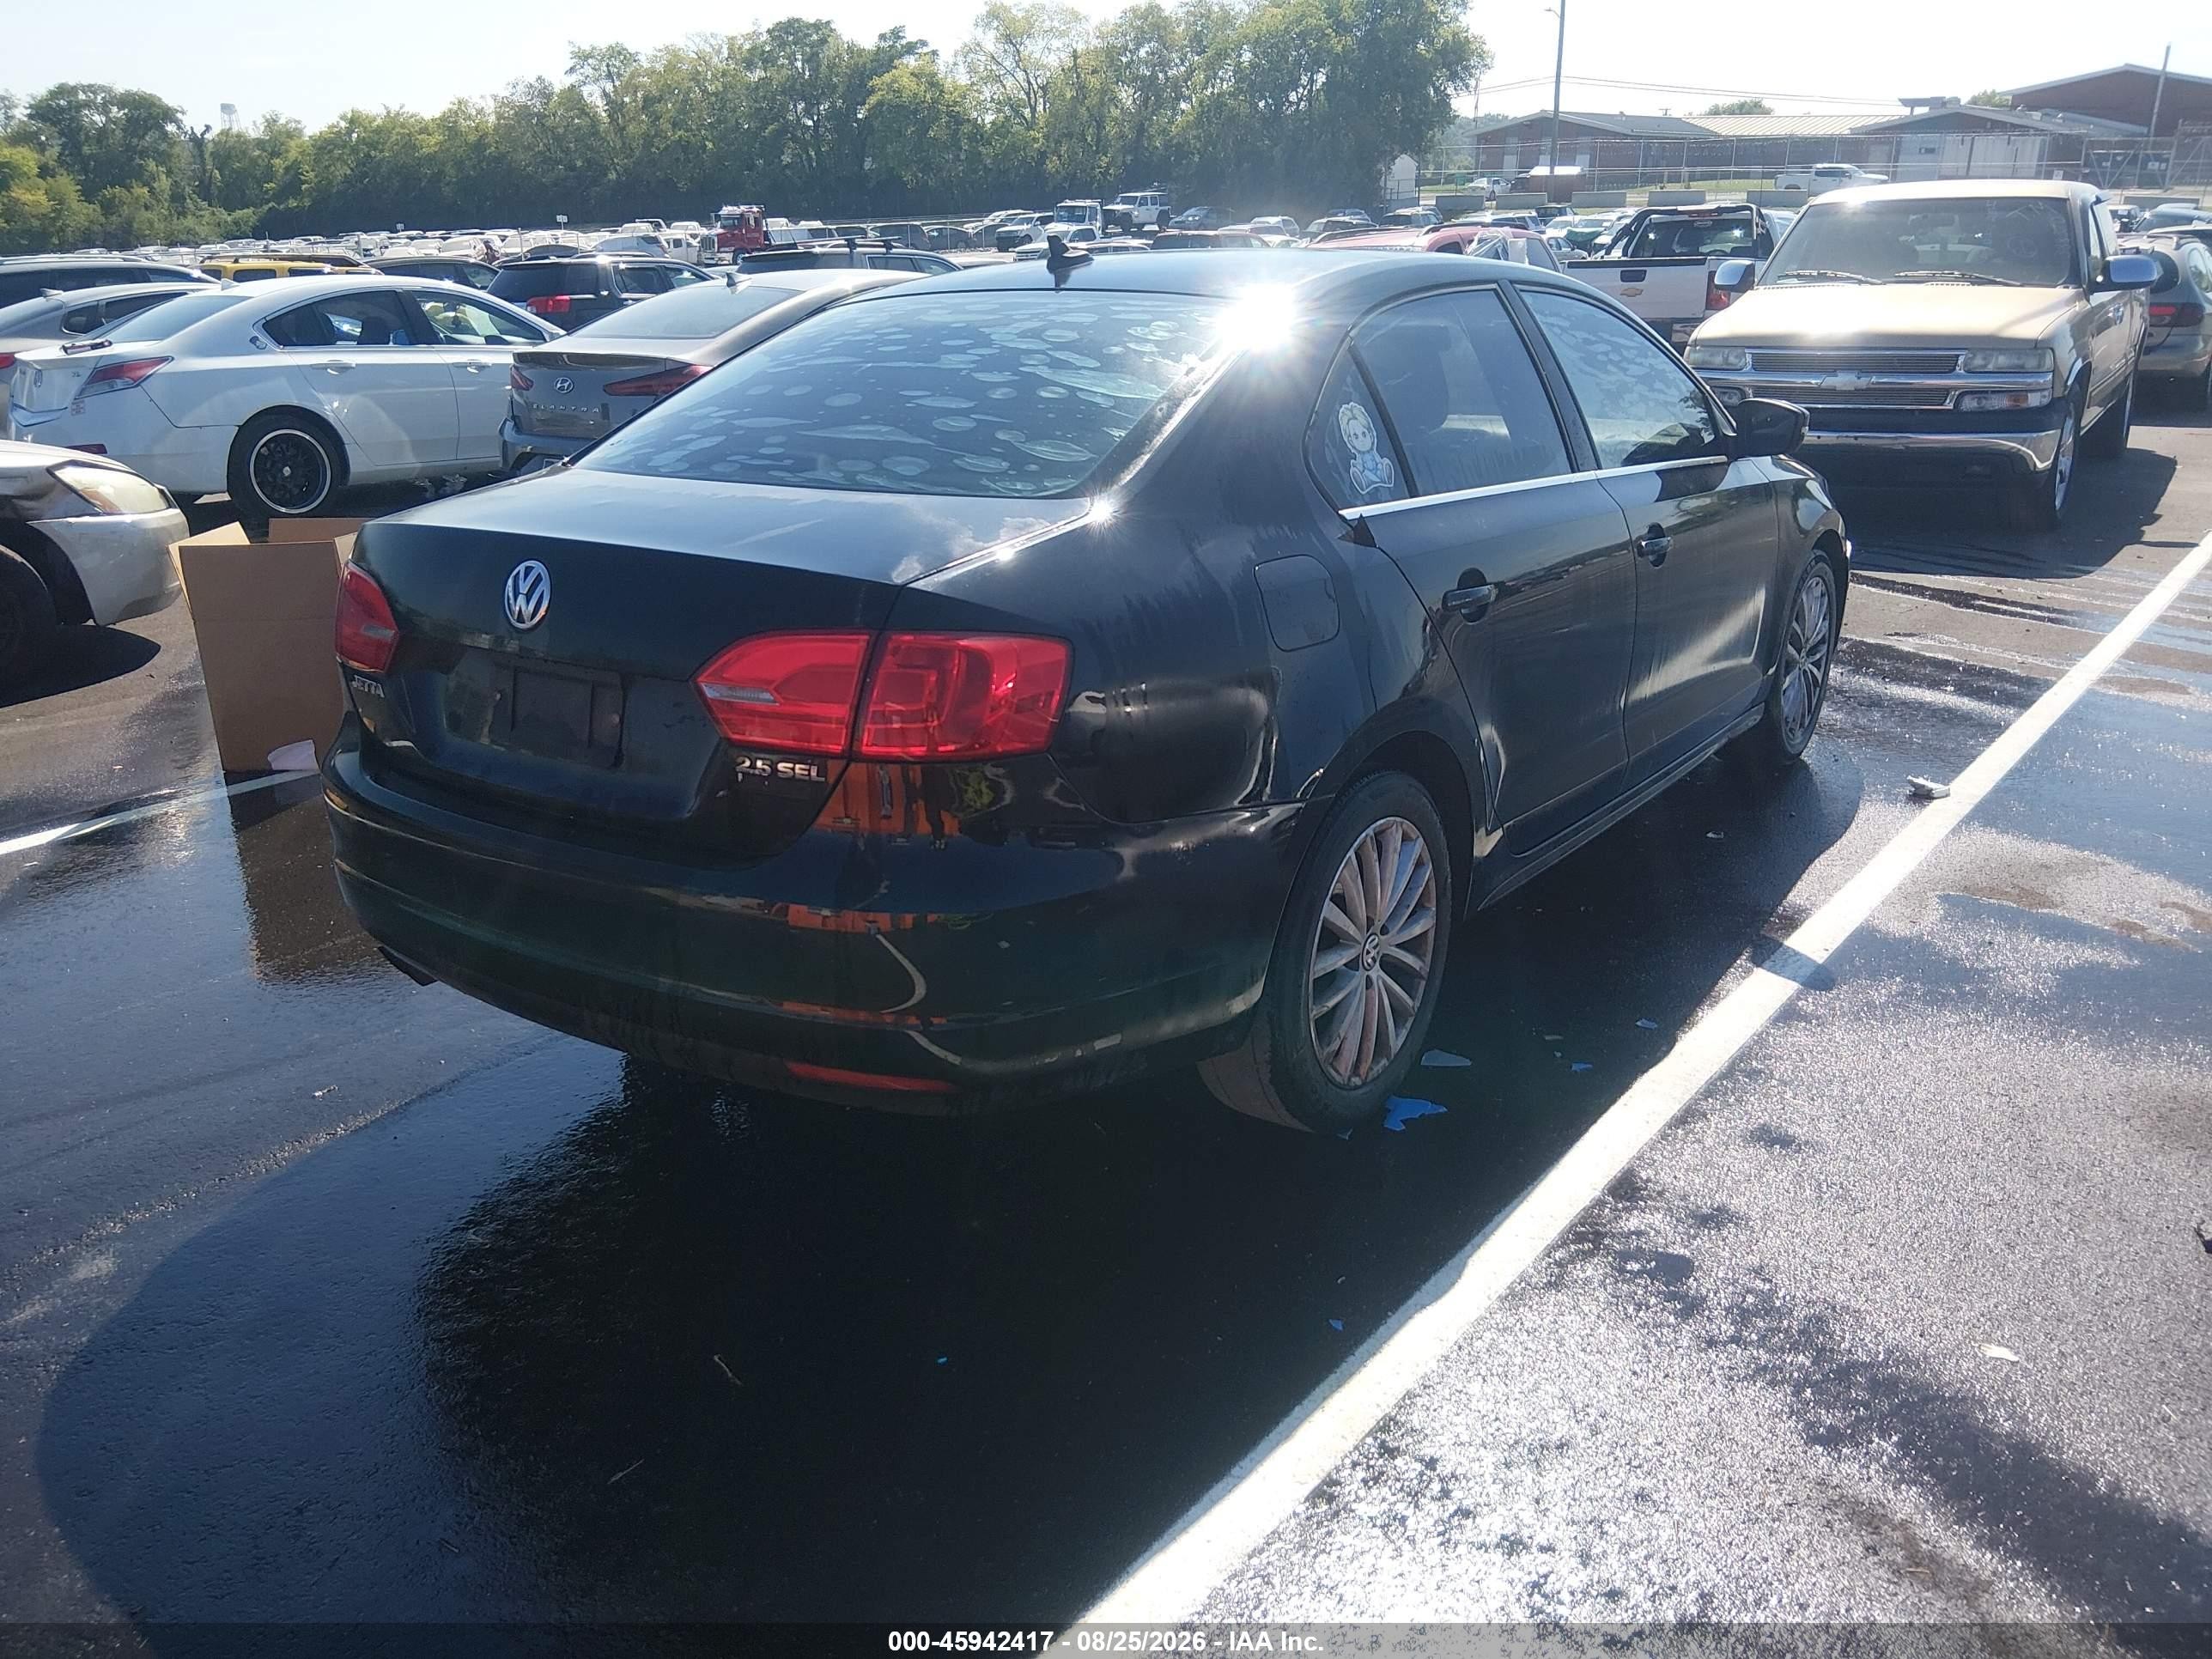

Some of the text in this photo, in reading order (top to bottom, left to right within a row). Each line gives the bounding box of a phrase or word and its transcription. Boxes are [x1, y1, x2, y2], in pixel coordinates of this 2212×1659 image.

[533, 404, 599, 413] ELANTRA
[347, 674, 385, 698] JETTA
[776, 761, 826, 782] SEL
